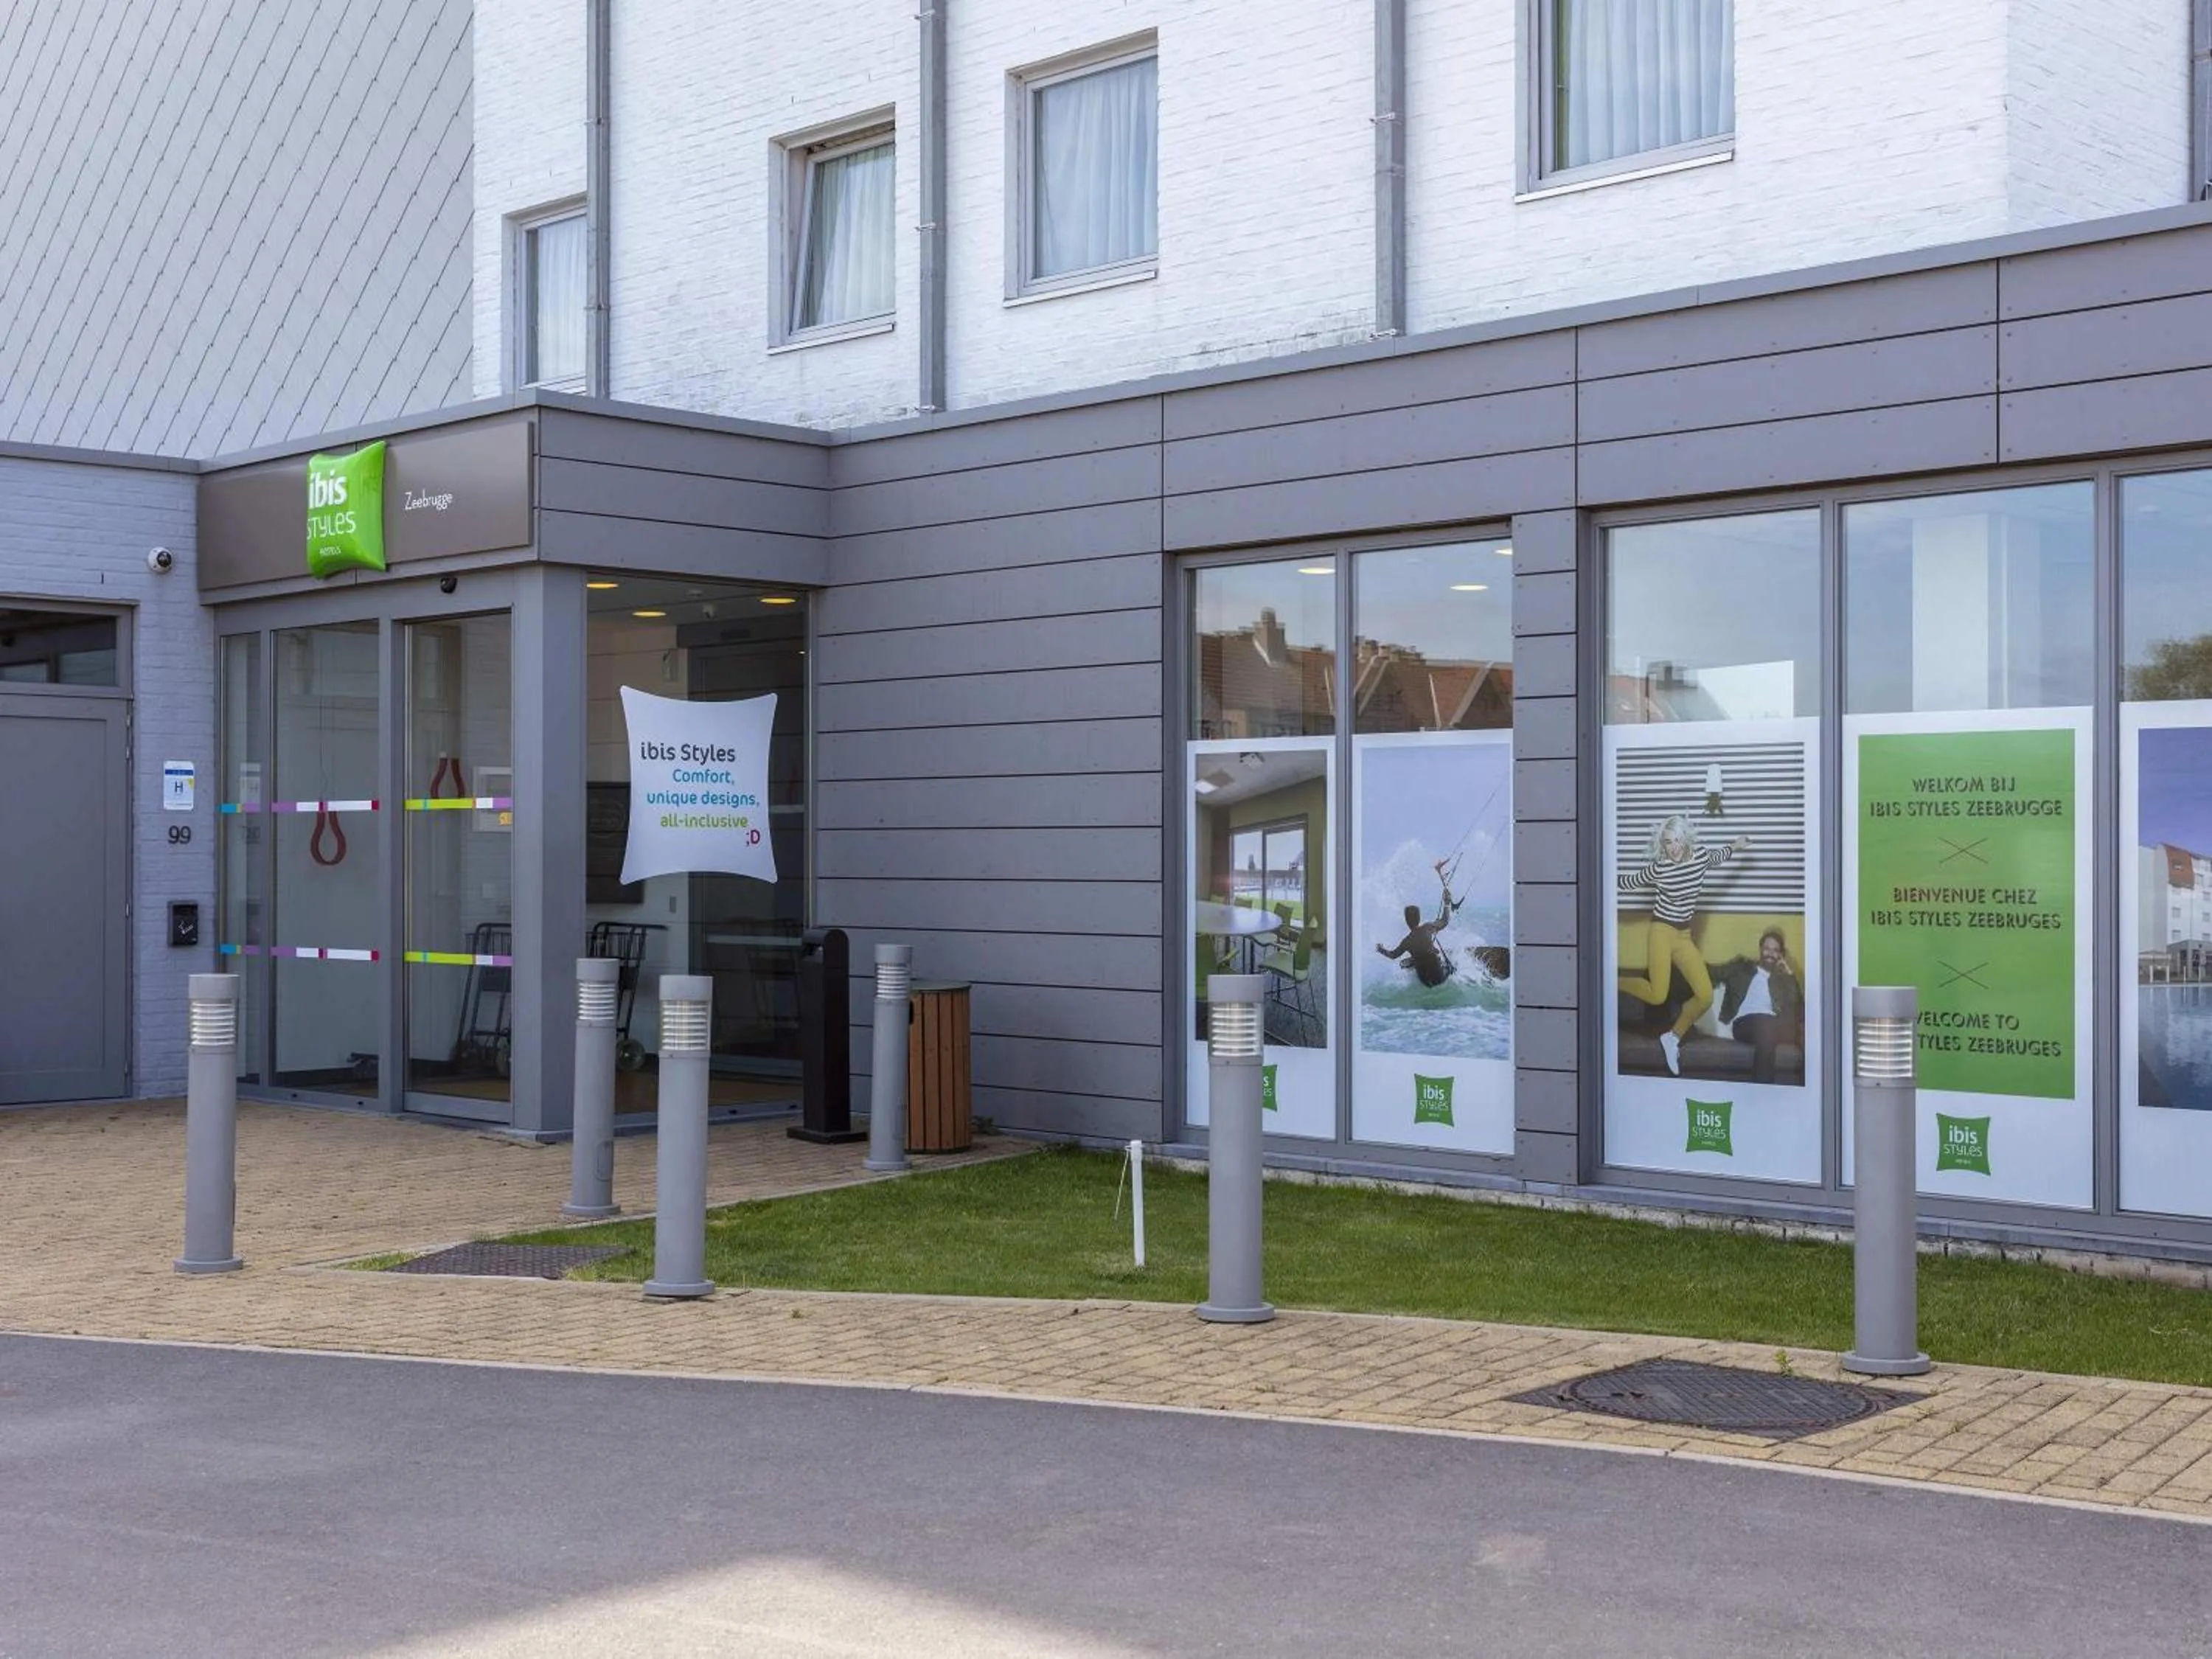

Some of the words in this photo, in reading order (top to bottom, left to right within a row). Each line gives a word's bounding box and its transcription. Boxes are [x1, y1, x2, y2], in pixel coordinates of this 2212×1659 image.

[309, 470, 347, 509] ibis
[405, 488, 453, 510] Zeebrugge
[640, 742, 675, 761] ibis
[681, 743, 736, 765] Styles
[672, 768, 734, 785] Comfort,
[1912, 776, 1984, 793] WELKOM
[1991, 776, 2017, 793] BIJ
[647, 790, 697, 807] unique
[701, 791, 759, 809] designs,
[1870, 801, 1902, 817] IBIS
[1907, 801, 1961, 817] STYLES
[1966, 799, 2063, 817] ZEEBRUGGE
[660, 814, 748, 828] all-inclusive
[168, 825, 192, 845] 99
[1893, 887, 1986, 904] BIENVENUE
[1992, 888, 2038, 905] CHEZ
[1871, 911, 1902, 926] IBIS
[1908, 911, 1961, 928] STYLES
[1968, 912, 2062, 930] ZEEBRUGES
[1995, 1014, 2020, 1031] TO
[1917, 1033, 1961, 1051] TYLES
[1968, 1036, 2062, 1057] ZEEBRUGES
[1423, 1084, 1445, 1100] ibis
[1697, 1109, 1722, 1127] ibis
[1949, 1124, 1978, 1144] ibis
